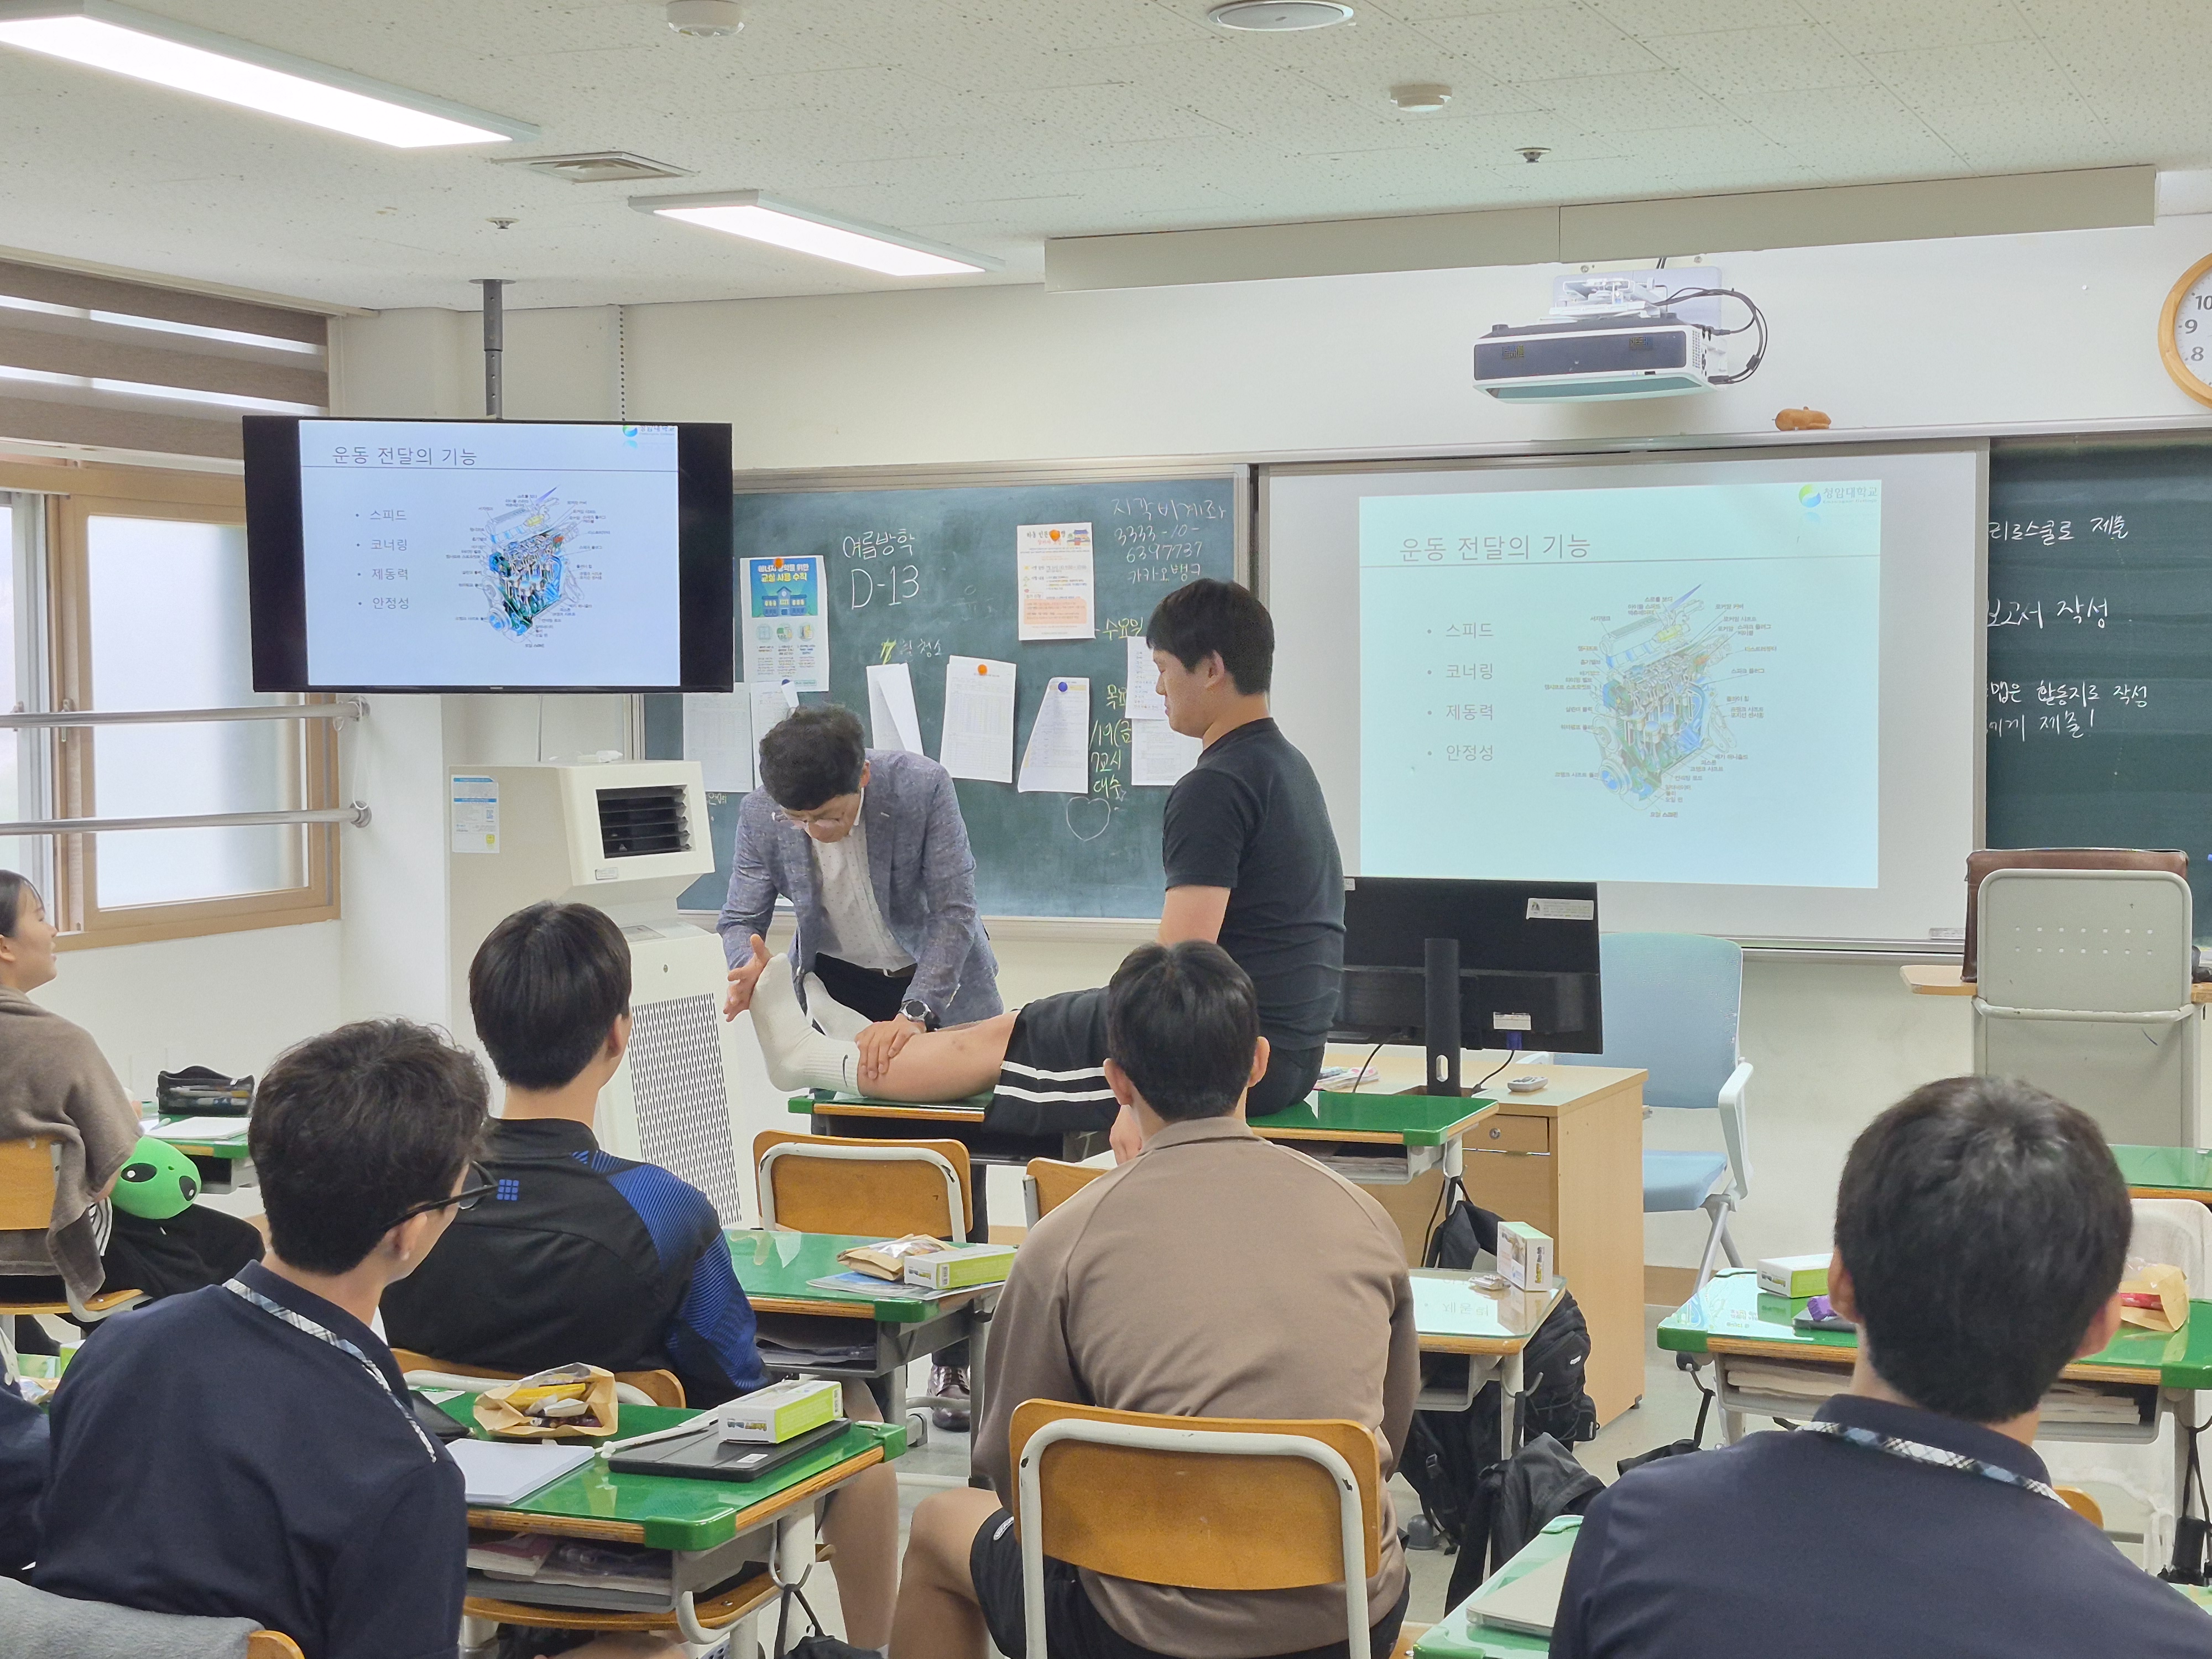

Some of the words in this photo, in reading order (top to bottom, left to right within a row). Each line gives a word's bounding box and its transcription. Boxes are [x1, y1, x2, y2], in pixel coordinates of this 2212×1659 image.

[2185, 319, 2198, 334] 9
[2190, 346, 2204, 361] 8
[332, 447, 369, 464] 운동
[378, 447, 431, 465] 전달의
[442, 448, 477, 466] 기능
[369, 509, 406, 521] 스피드
[371, 539, 407, 551] 코너링
[843, 529, 915, 560] 여름방학
[1400, 538, 1446, 562] 운동
[1458, 535, 1528, 560] 전달의
[1543, 534, 1590, 559] 기능
[372, 568, 408, 580] 제동력
[761, 573, 775, 582] 교실
[777, 572, 791, 582] 사용
[1126, 563, 1201, 584] 카카오뱅크
[852, 565, 919, 610] D-13
[373, 597, 409, 609] 안정성
[1987, 598, 2043, 629] 보고서
[2057, 594, 2109, 629] 작성
[1102, 617, 1144, 641] 수요일
[1446, 622, 1494, 639] 스피드
[1446, 663, 1493, 680] 코너링
[1989, 681, 2022, 703] 맵은
[2036, 680, 2100, 707] 활동지로
[2113, 684, 2148, 708] 작성
[1446, 703, 1493, 721] 제동력
[1988, 713, 2026, 742] 에게
[1091, 749, 1121, 773] 7교시
[1446, 744, 1494, 762] 안정성
